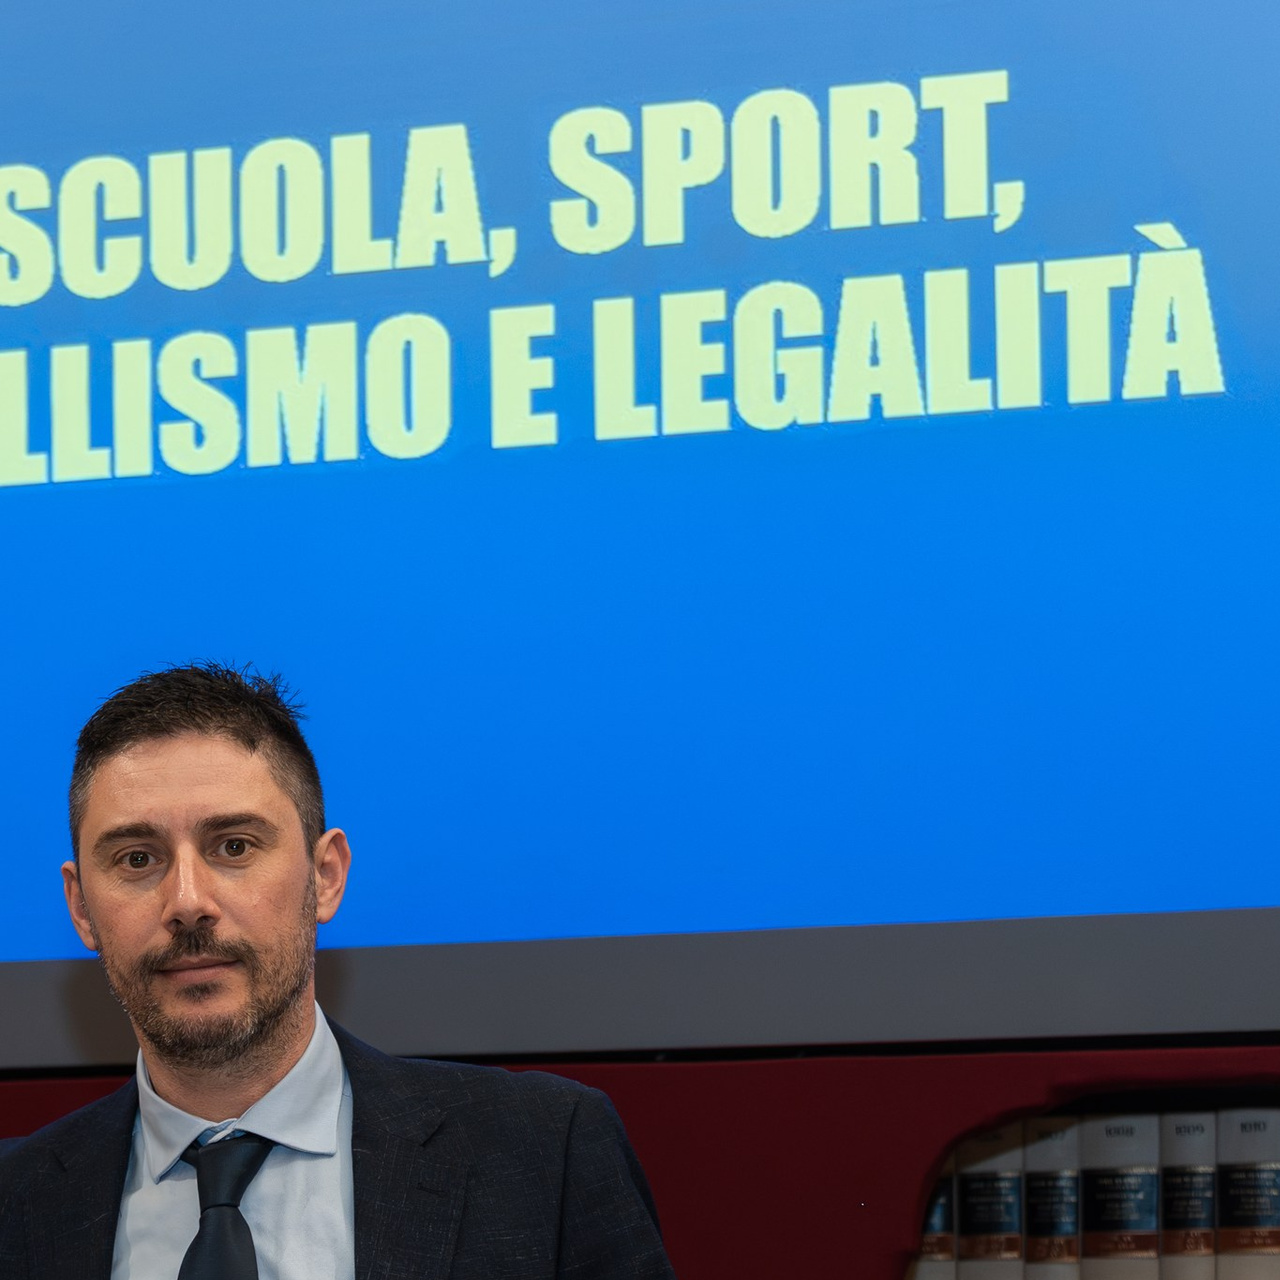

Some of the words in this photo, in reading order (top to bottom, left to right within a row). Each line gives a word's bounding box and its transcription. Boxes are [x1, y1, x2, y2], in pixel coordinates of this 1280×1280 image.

[548, 69, 1026, 255] SPORT,
[489, 303, 558, 449] E
[592, 221, 1227, 441] LEGALITÀ
